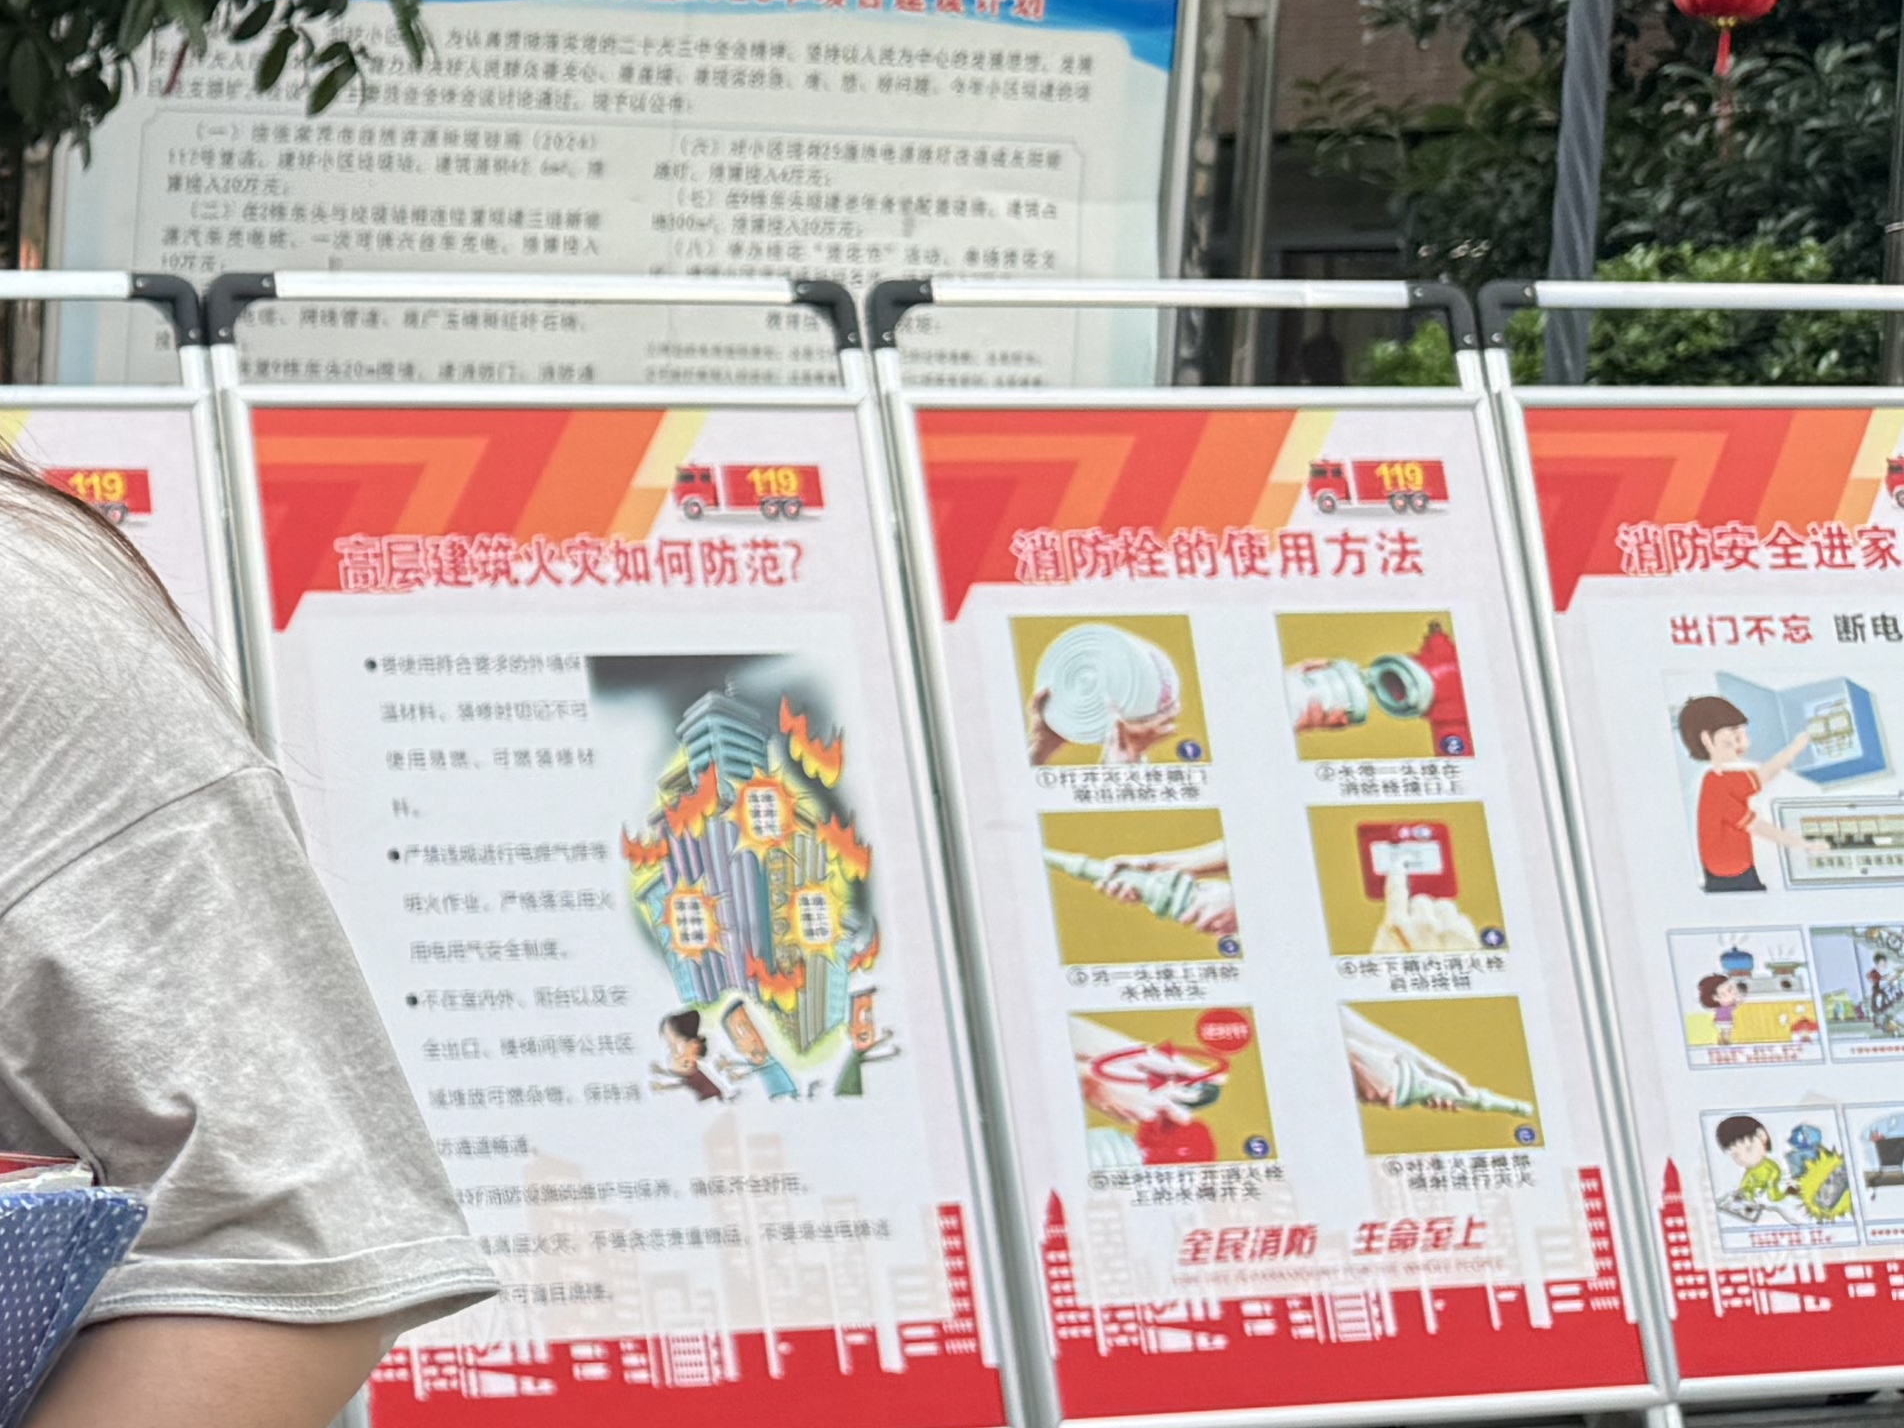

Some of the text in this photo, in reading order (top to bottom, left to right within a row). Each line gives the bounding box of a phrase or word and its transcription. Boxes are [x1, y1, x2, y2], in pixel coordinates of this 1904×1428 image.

[69, 471, 128, 503] 119
[746, 467, 798, 496] 119
[1376, 462, 1423, 491] 119
[1008, 525, 1425, 585] 消防栓的使用方法
[1616, 520, 1903, 577] 消防安全进家
[1669, 613, 1904, 646] 出门不忘 断电
[1180, 1215, 1490, 1266] 全民消防 生命至上
